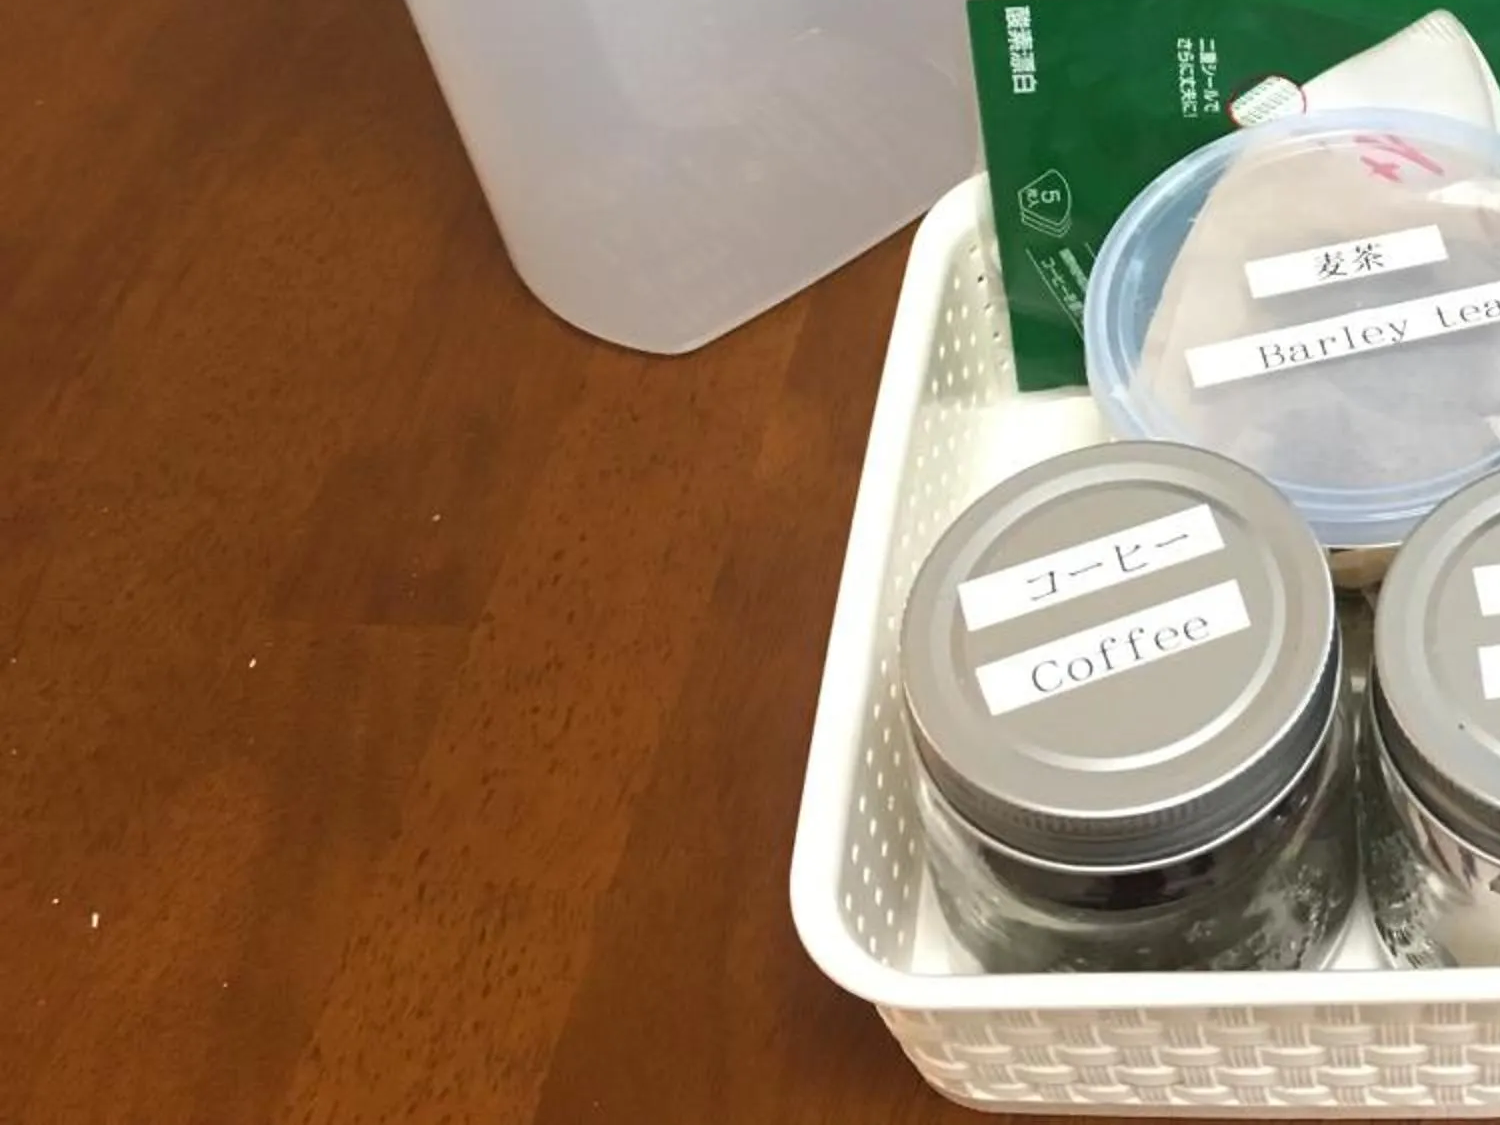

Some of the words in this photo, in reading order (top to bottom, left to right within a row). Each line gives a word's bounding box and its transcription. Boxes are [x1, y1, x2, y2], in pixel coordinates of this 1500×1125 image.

[1318, 243, 1385, 278] 麦茶
[1258, 317, 1408, 370] Barley
[1027, 533, 1191, 602] コーヒー
[1031, 611, 1209, 694] Coffee
